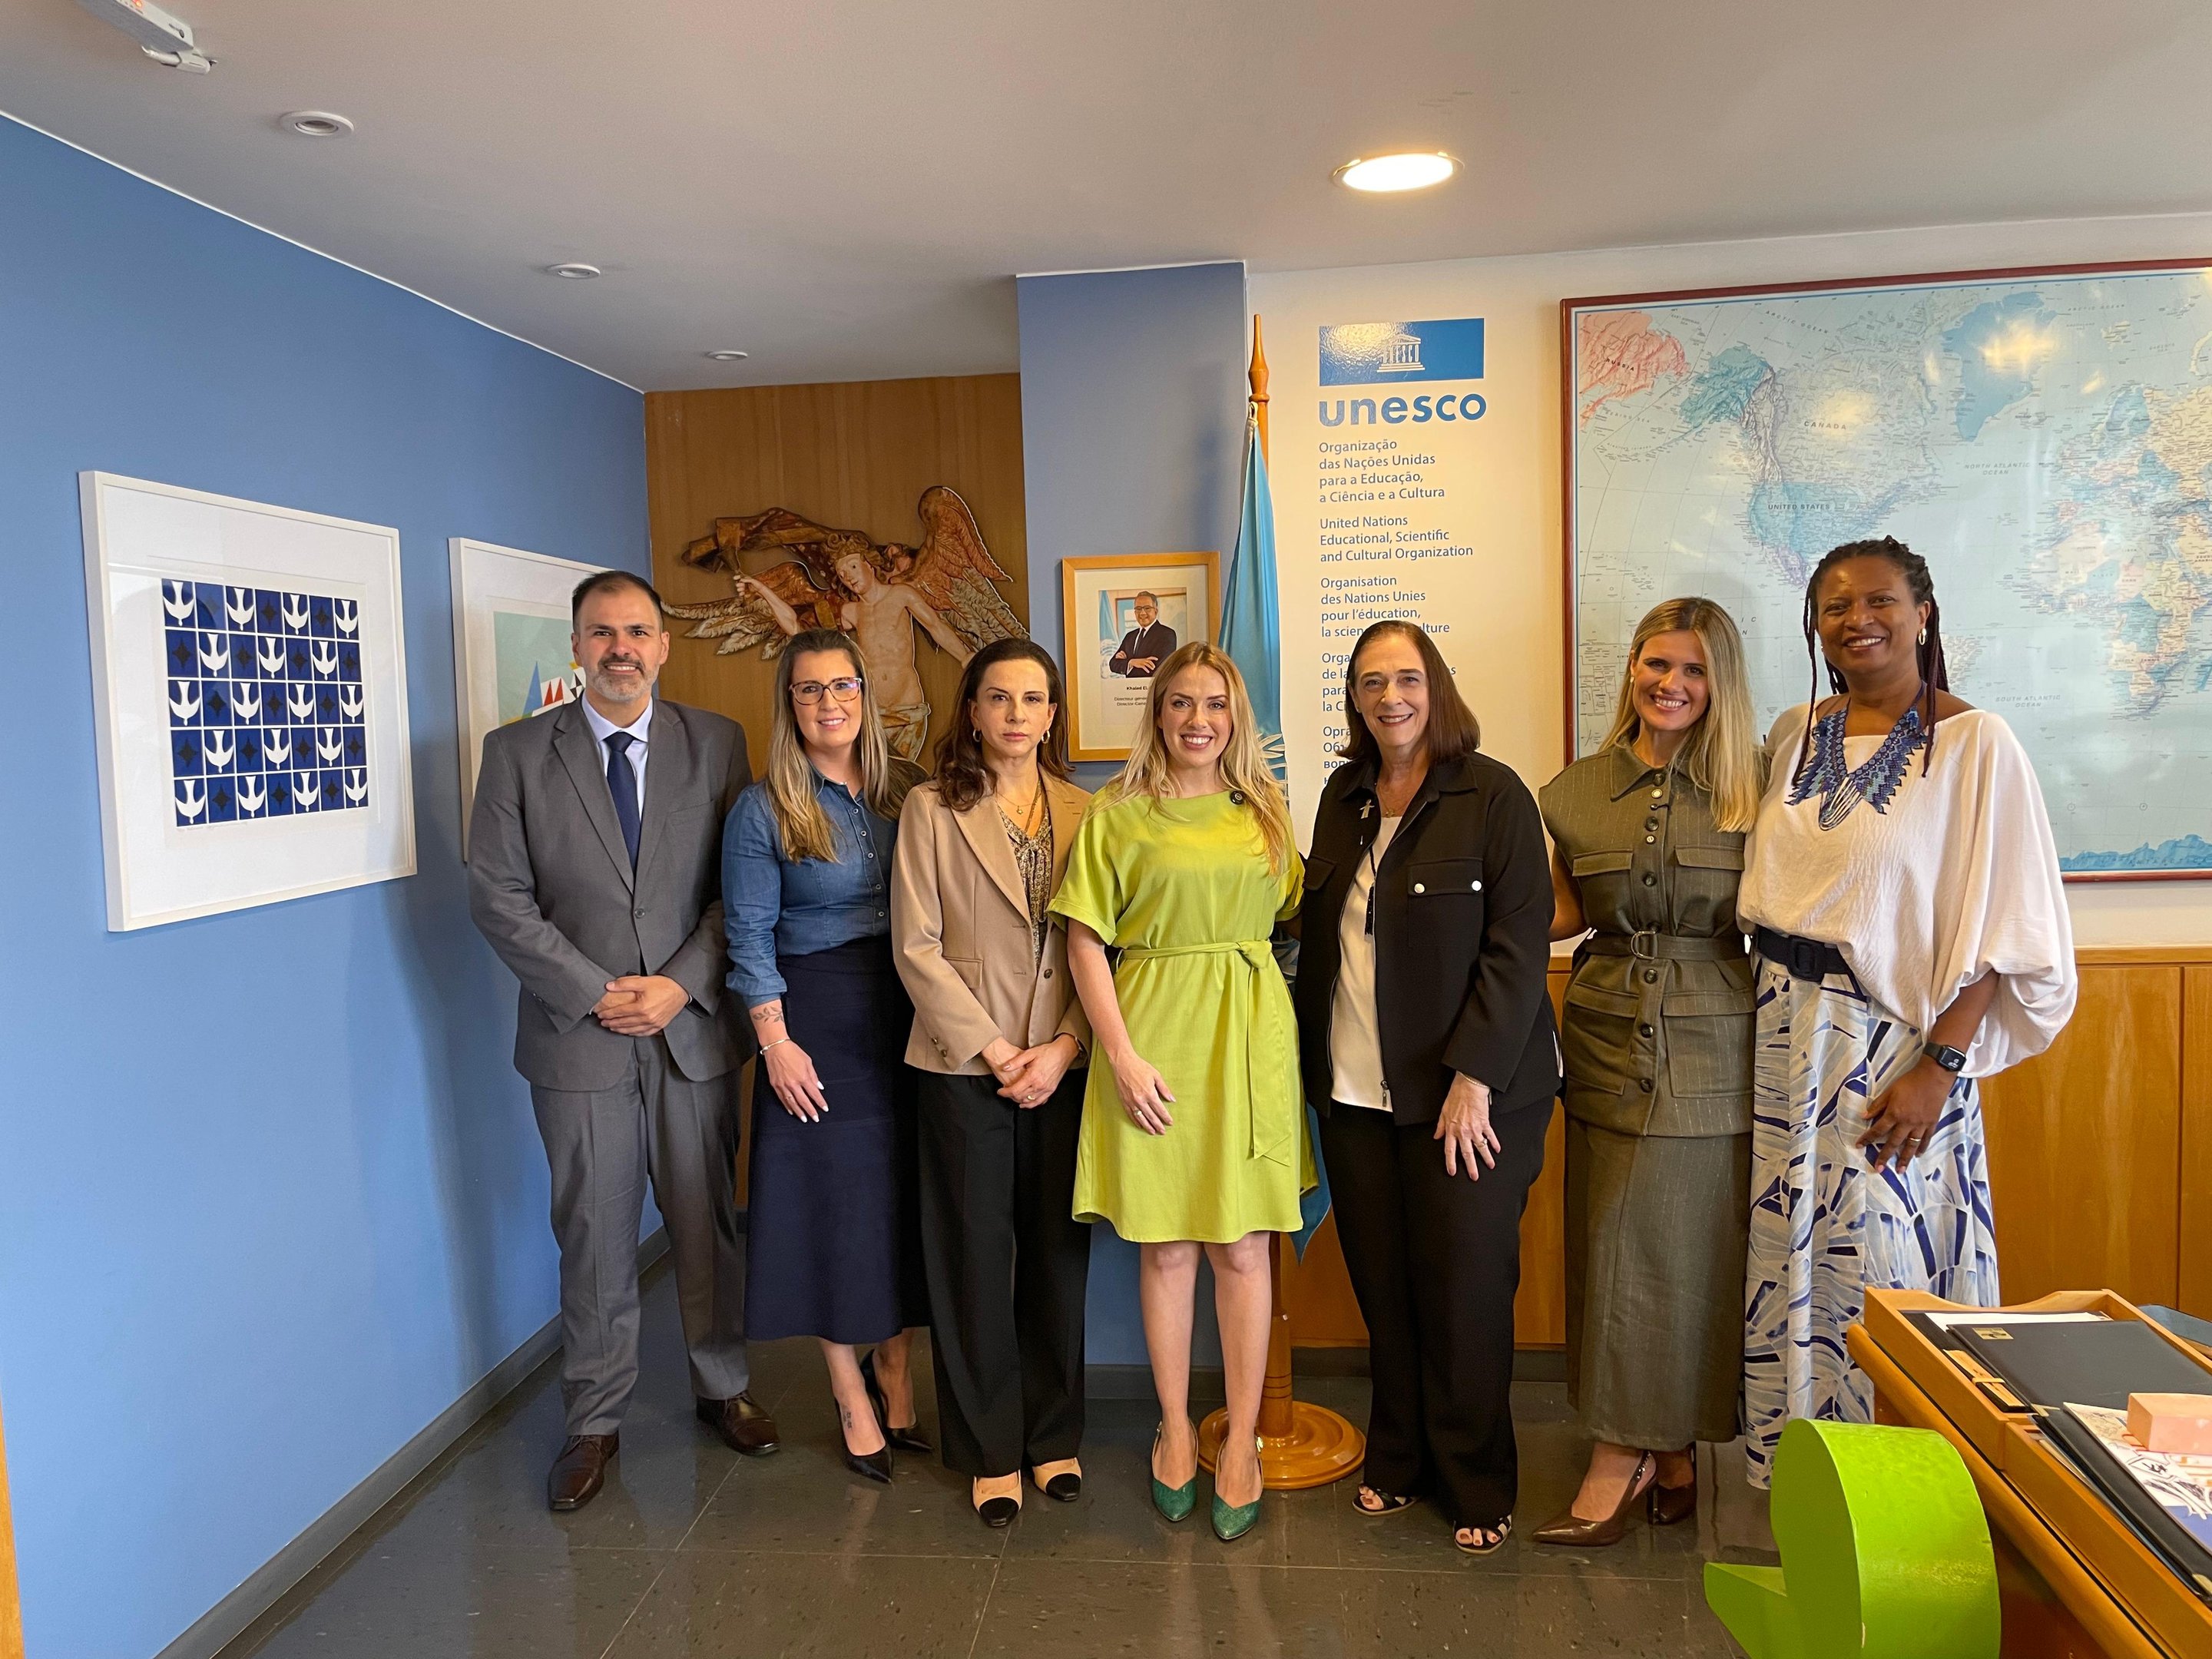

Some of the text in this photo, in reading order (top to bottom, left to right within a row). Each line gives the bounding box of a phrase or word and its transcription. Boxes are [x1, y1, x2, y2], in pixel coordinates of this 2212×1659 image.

[1606, 358, 1634, 372] RUSSIA
[1319, 393, 1487, 427] unesco
[1803, 421, 1847, 430] CANADA
[1319, 439, 1397, 455] Organização
[1319, 454, 1435, 471] das Nações Unidas
[1320, 477, 1346, 489] para
[1360, 471, 1424, 485] Educação,
[1319, 486, 1445, 503] a Ciência e a Cultura
[1320, 515, 1408, 529] United Nations
[1320, 528, 1450, 546] Educational, Scientific
[1320, 545, 1473, 562] and Cultural Organization
[1320, 575, 1397, 591] Organisation
[1320, 590, 1426, 605] des Nations Unies
[1321, 611, 1349, 624] pour
[1321, 623, 1450, 637] la scien lture
[1322, 668, 1348, 680] de la
[1323, 701, 1333, 712] la
